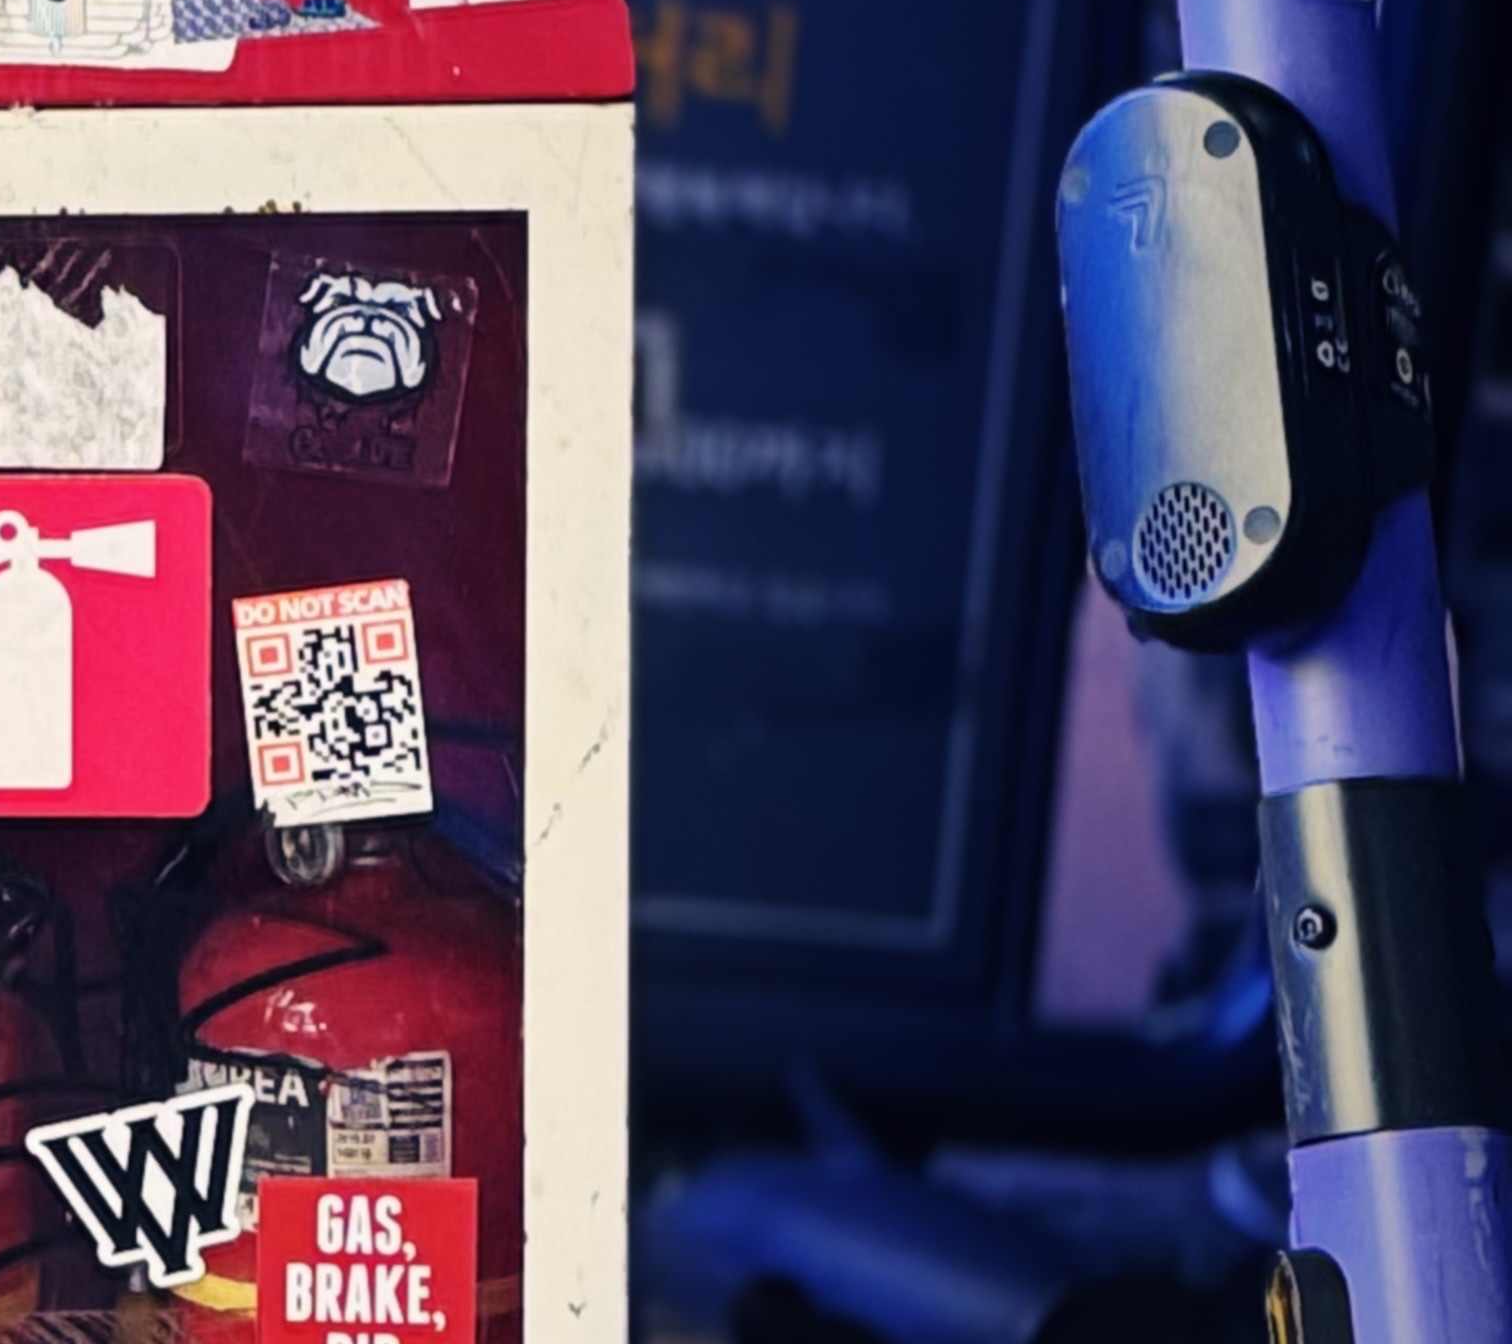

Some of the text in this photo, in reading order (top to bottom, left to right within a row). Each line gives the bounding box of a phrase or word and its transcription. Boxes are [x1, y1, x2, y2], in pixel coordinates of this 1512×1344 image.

[239, 582, 406, 626] DO NOT SCAN
[316, 1194, 417, 1262] GAS,
[286, 1262, 447, 1333] BRAKE,
